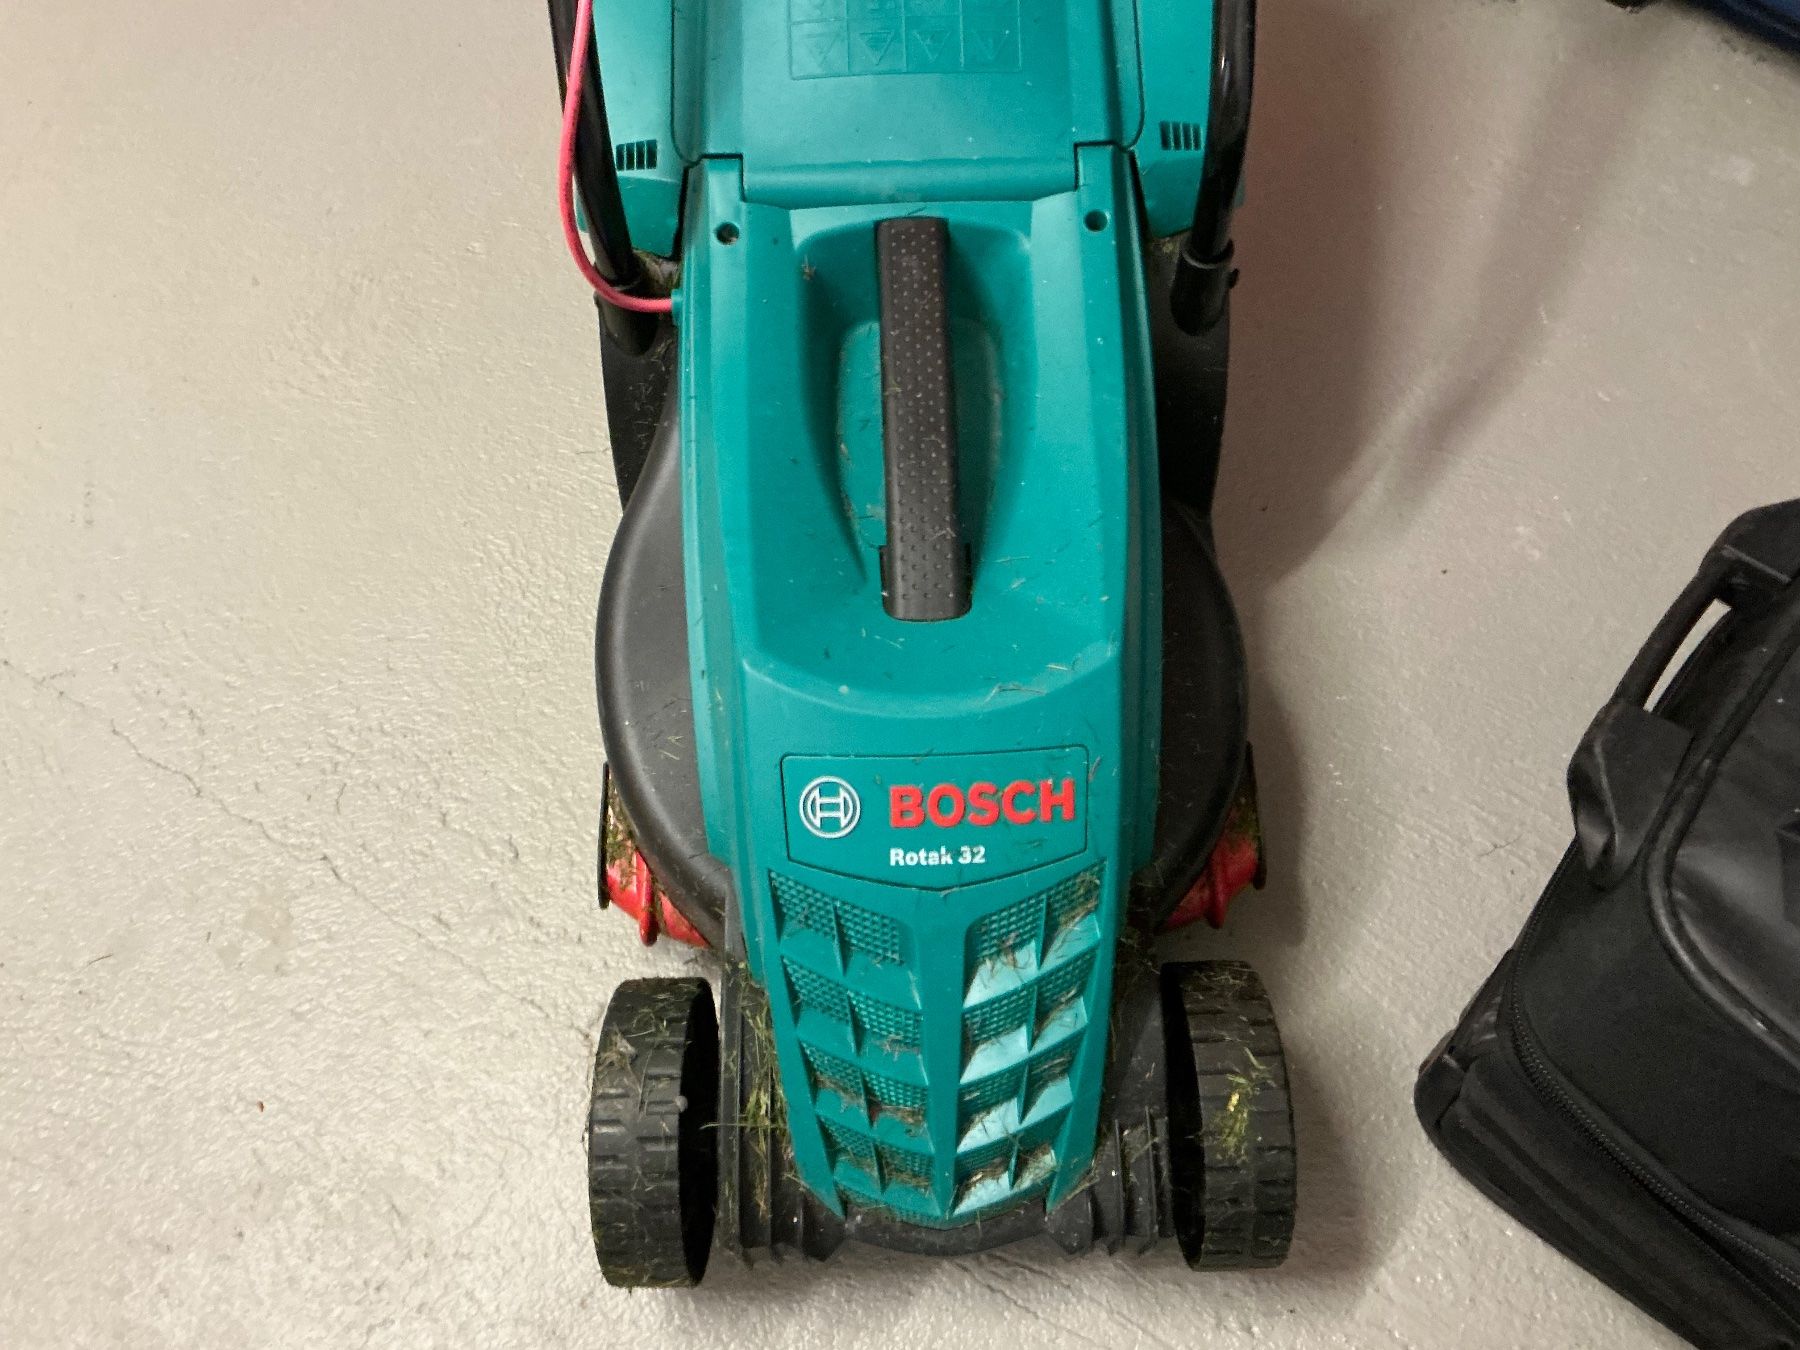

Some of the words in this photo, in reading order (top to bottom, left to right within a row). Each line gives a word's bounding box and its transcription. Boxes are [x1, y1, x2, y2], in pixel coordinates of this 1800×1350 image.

[889, 778, 1075, 828] BOSCH
[889, 846, 953, 867] Rotak
[958, 845, 986, 864] 32
